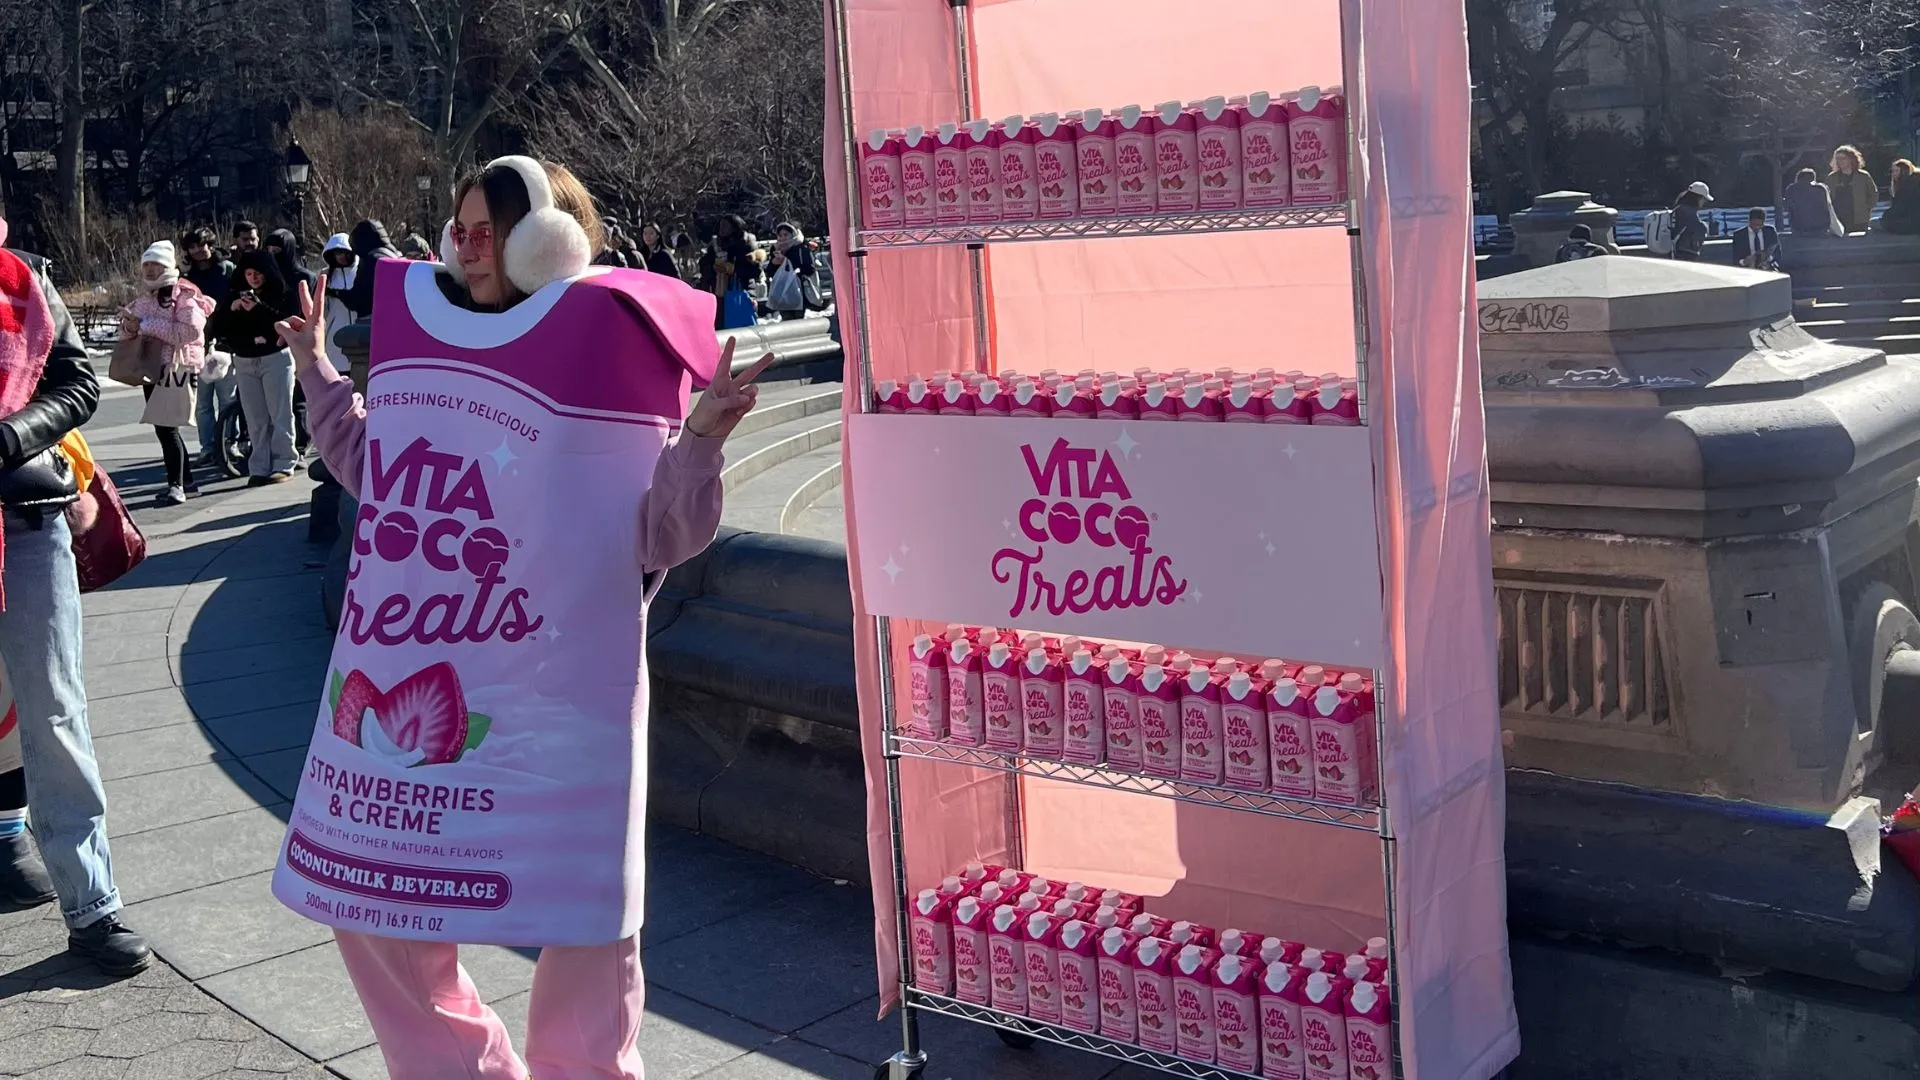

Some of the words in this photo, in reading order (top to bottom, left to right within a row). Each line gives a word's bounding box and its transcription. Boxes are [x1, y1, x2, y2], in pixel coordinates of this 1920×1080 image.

[468, 401, 540, 442] DELICIOUS
[370, 436, 494, 521] VITA
[1020, 437, 1132, 500] VITA
[354, 503, 509, 577] COCO
[1019, 498, 1150, 549] COCO
[340, 560, 544, 646] reats
[991, 535, 1187, 618] Treats
[310, 755, 495, 813] STRAWBERRIES
[326, 826, 349, 841] WITH
[352, 834, 388, 849] OTHER
[392, 841, 446, 857] NATURAL
[450, 847, 504, 860] FLAVORS
[328, 793, 342, 818] &
[350, 798, 442, 835] CREME
[290, 840, 386, 891] COCONUTMILK
[391, 875, 498, 900] BEVERAGE
[305, 891, 332, 914] 500mL
[336, 901, 361, 922] (1.05
[364, 908, 381, 928] PT)
[386, 912, 408, 929] 16.9
[412, 917, 424, 930] FL
[428, 918, 443, 932] OZ
